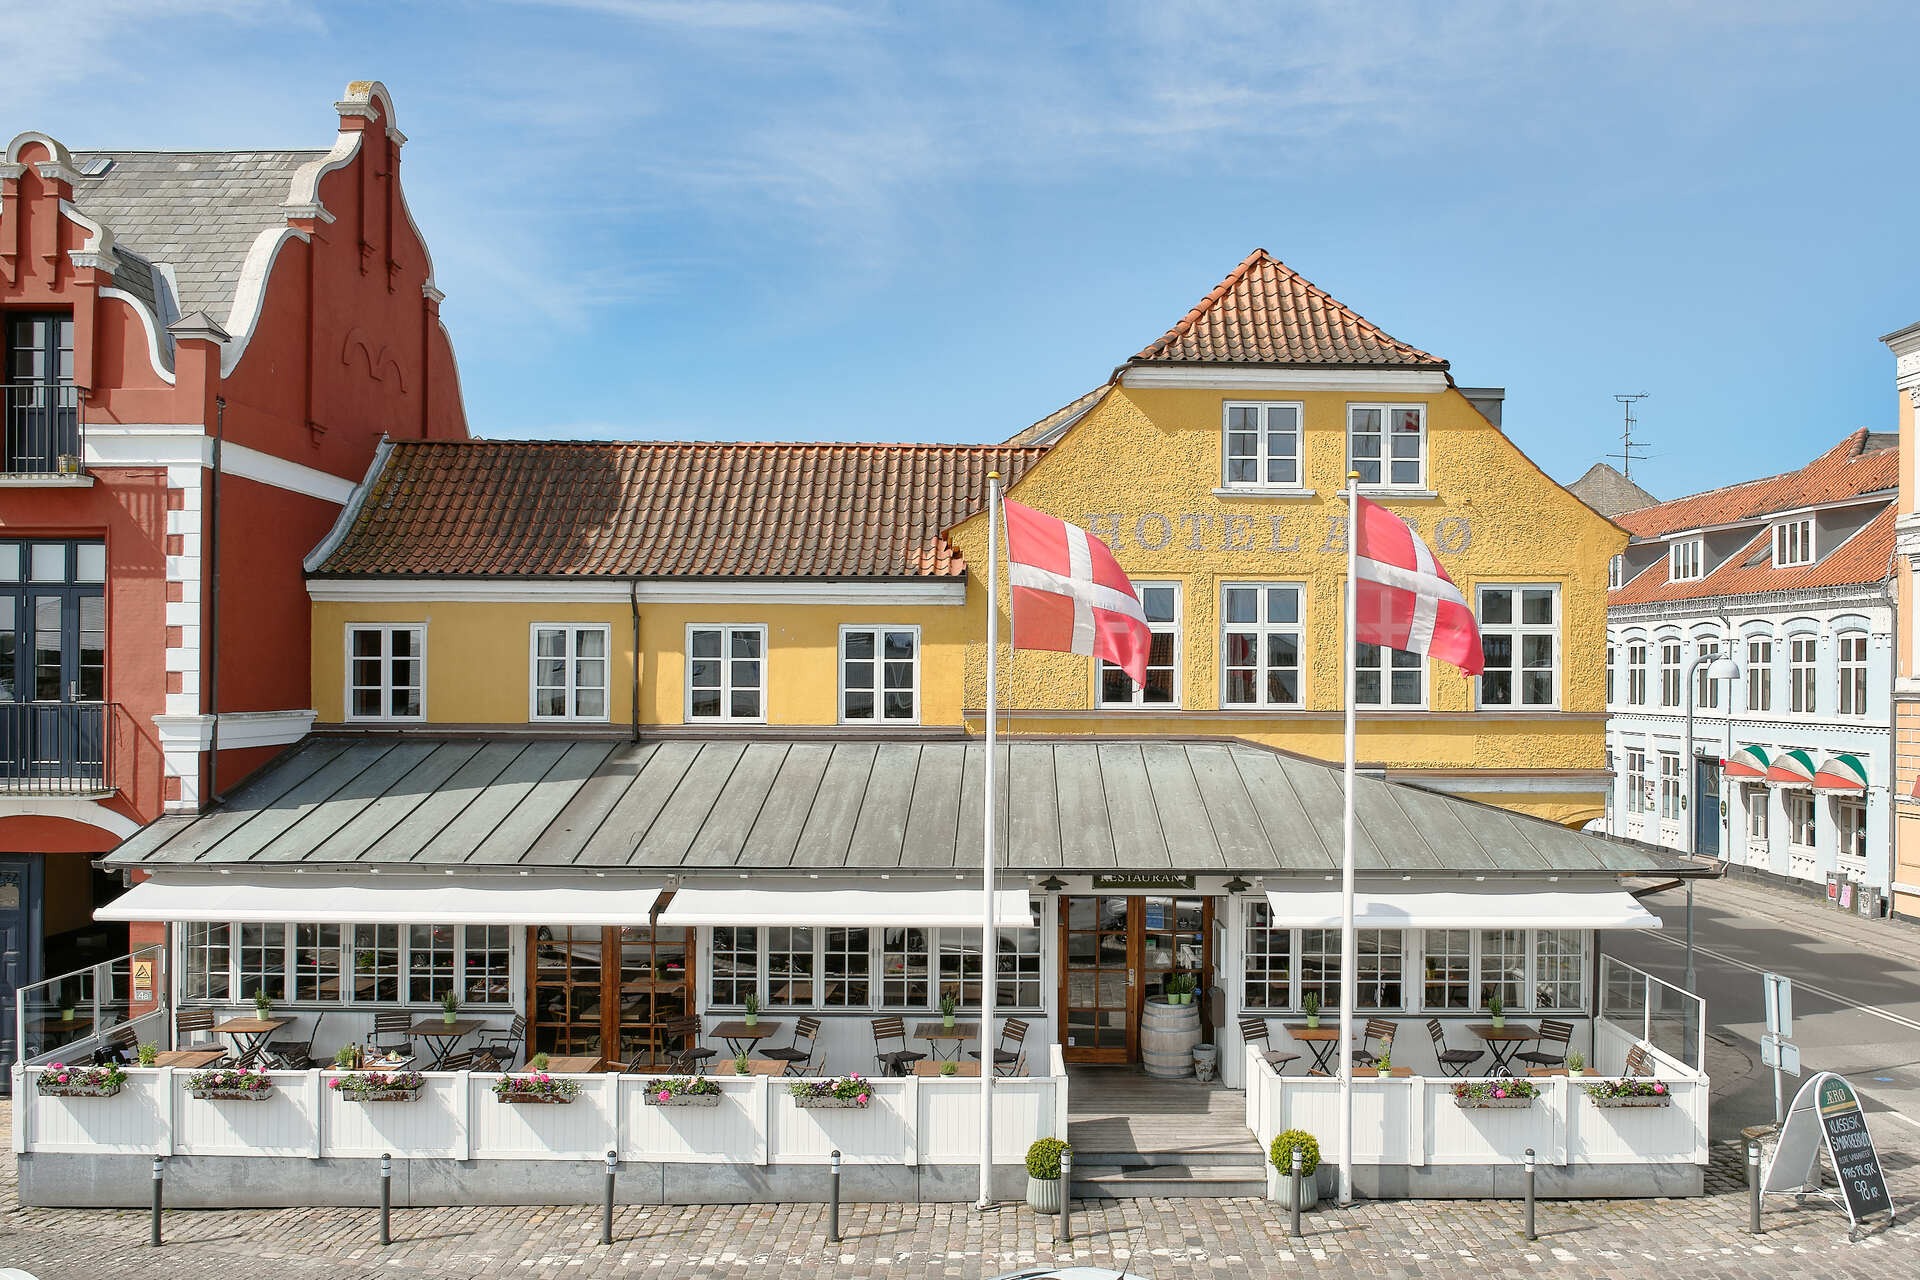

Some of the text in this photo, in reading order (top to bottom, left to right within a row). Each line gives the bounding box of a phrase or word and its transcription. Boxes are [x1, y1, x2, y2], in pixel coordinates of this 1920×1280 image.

[1085, 513, 1299, 552] HOTEL
[1829, 1115, 1861, 1132] KLASSISK
[1854, 1180, 1870, 1200] 98
